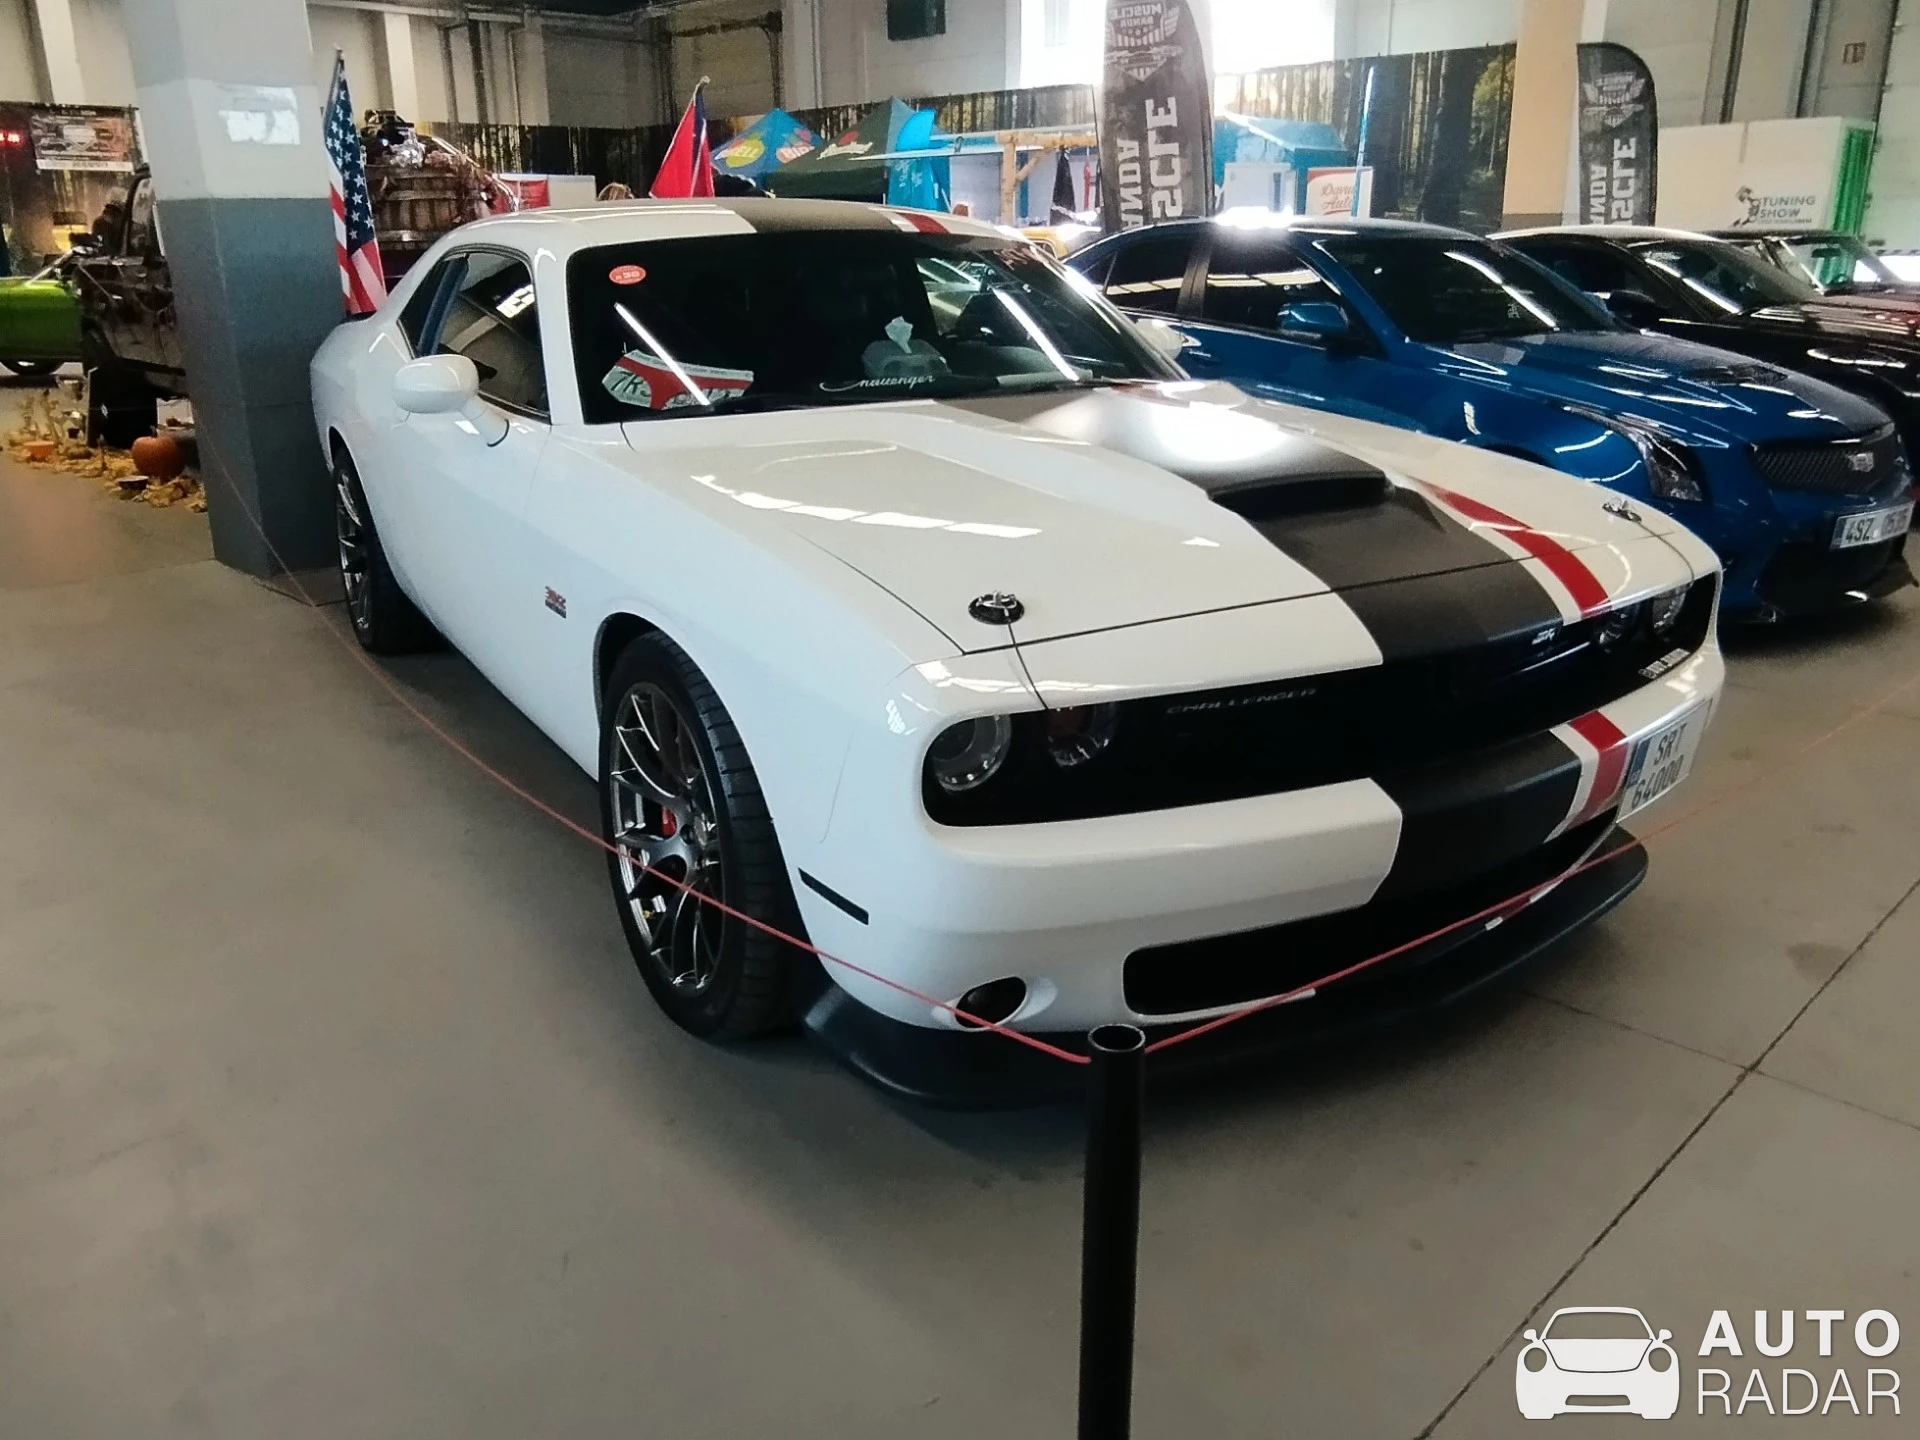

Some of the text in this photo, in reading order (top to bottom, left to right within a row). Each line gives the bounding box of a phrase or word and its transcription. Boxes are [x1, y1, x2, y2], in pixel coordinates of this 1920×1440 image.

[1760, 195, 1816, 207] TUNING
[1760, 208, 1801, 218] SHOW
[1654, 722, 1688, 766] SRT
[1631, 754, 1685, 809] 64000
